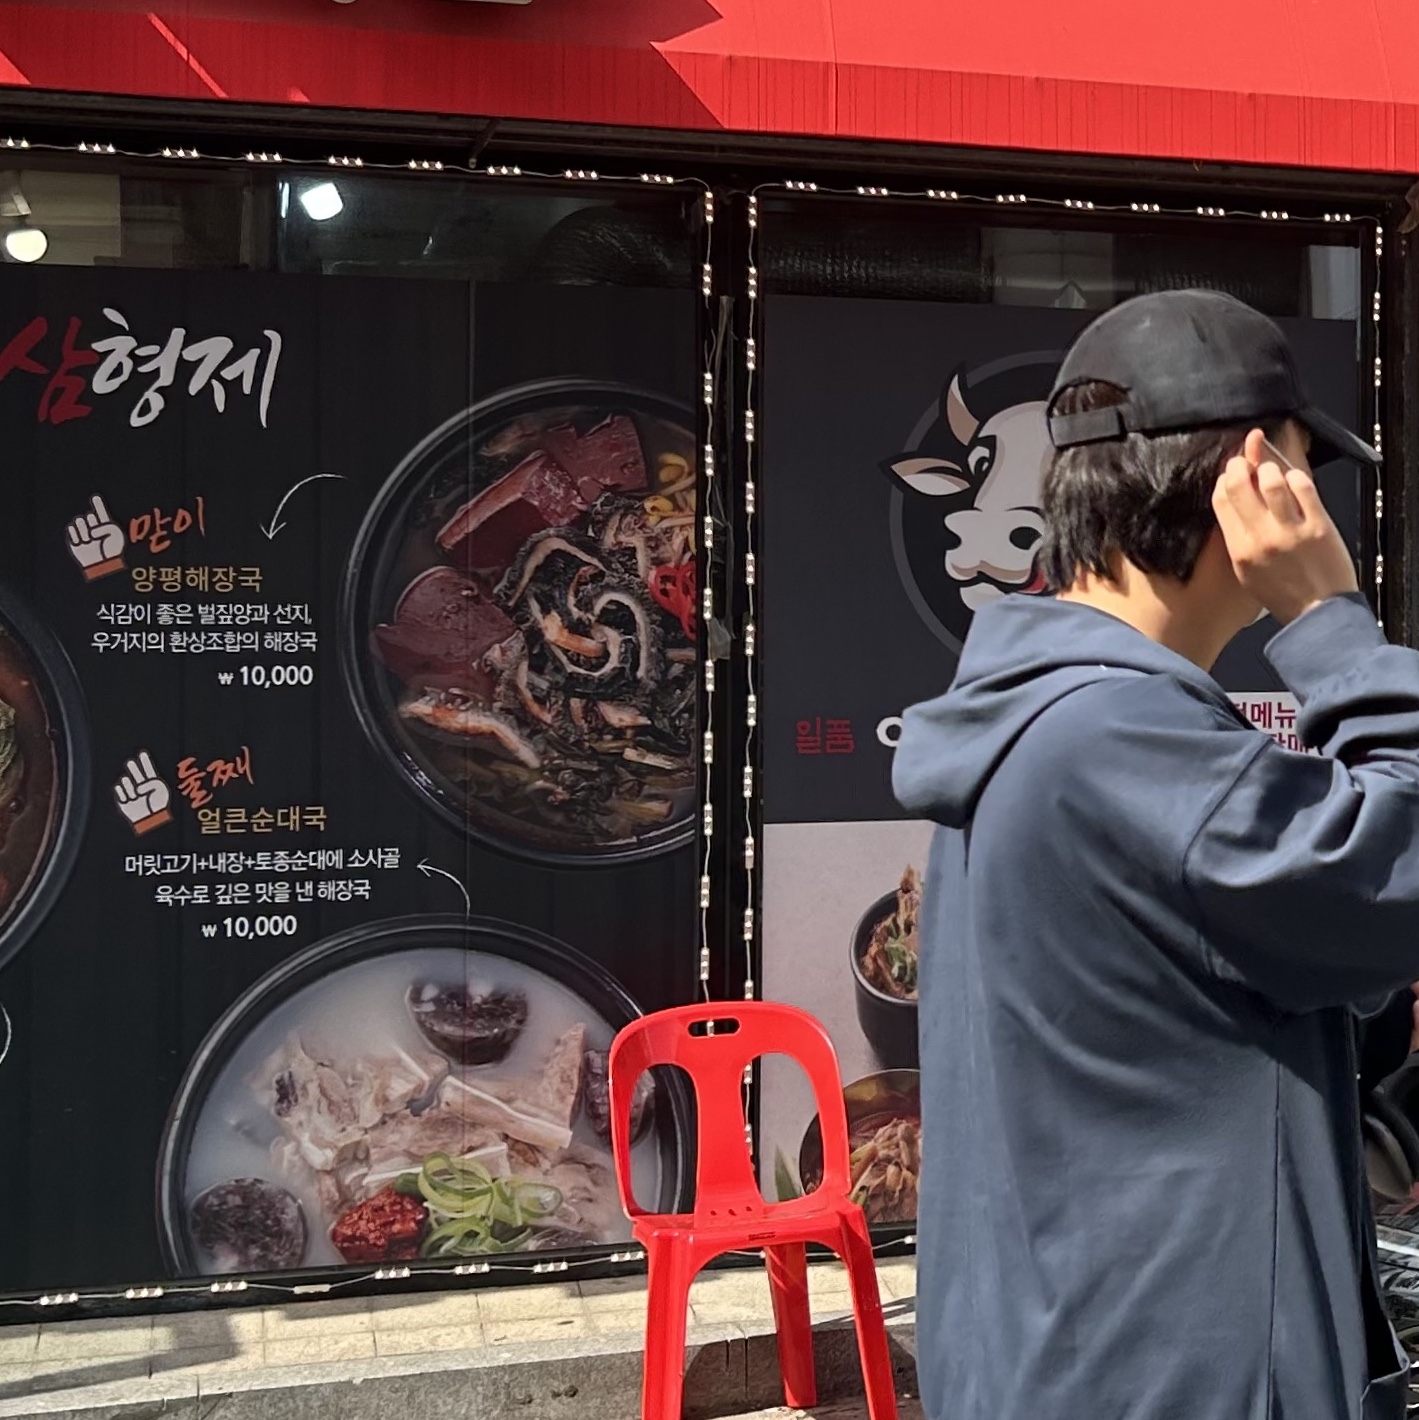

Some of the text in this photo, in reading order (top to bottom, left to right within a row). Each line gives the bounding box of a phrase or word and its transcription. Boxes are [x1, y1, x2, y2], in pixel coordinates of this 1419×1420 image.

[131, 566, 263, 593] 양평해장국
[97, 603, 313, 625] 식감이 좋은 벌짚양과 선지,
[91, 631, 318, 653] 우거지의 환상조합의 해장국
[240, 665, 314, 688] 10,000
[1235, 702, 1296, 729] 메뉴
[176, 746, 254, 809] 둘째
[197, 806, 327, 835] 얼큰순대국
[124, 847, 400, 876] 머릿고기+내장+토종순대에 소사골
[155, 879, 371, 906] 육수로 깊은 맛을 낸 해장국
[223, 915, 297, 940] 10,000
